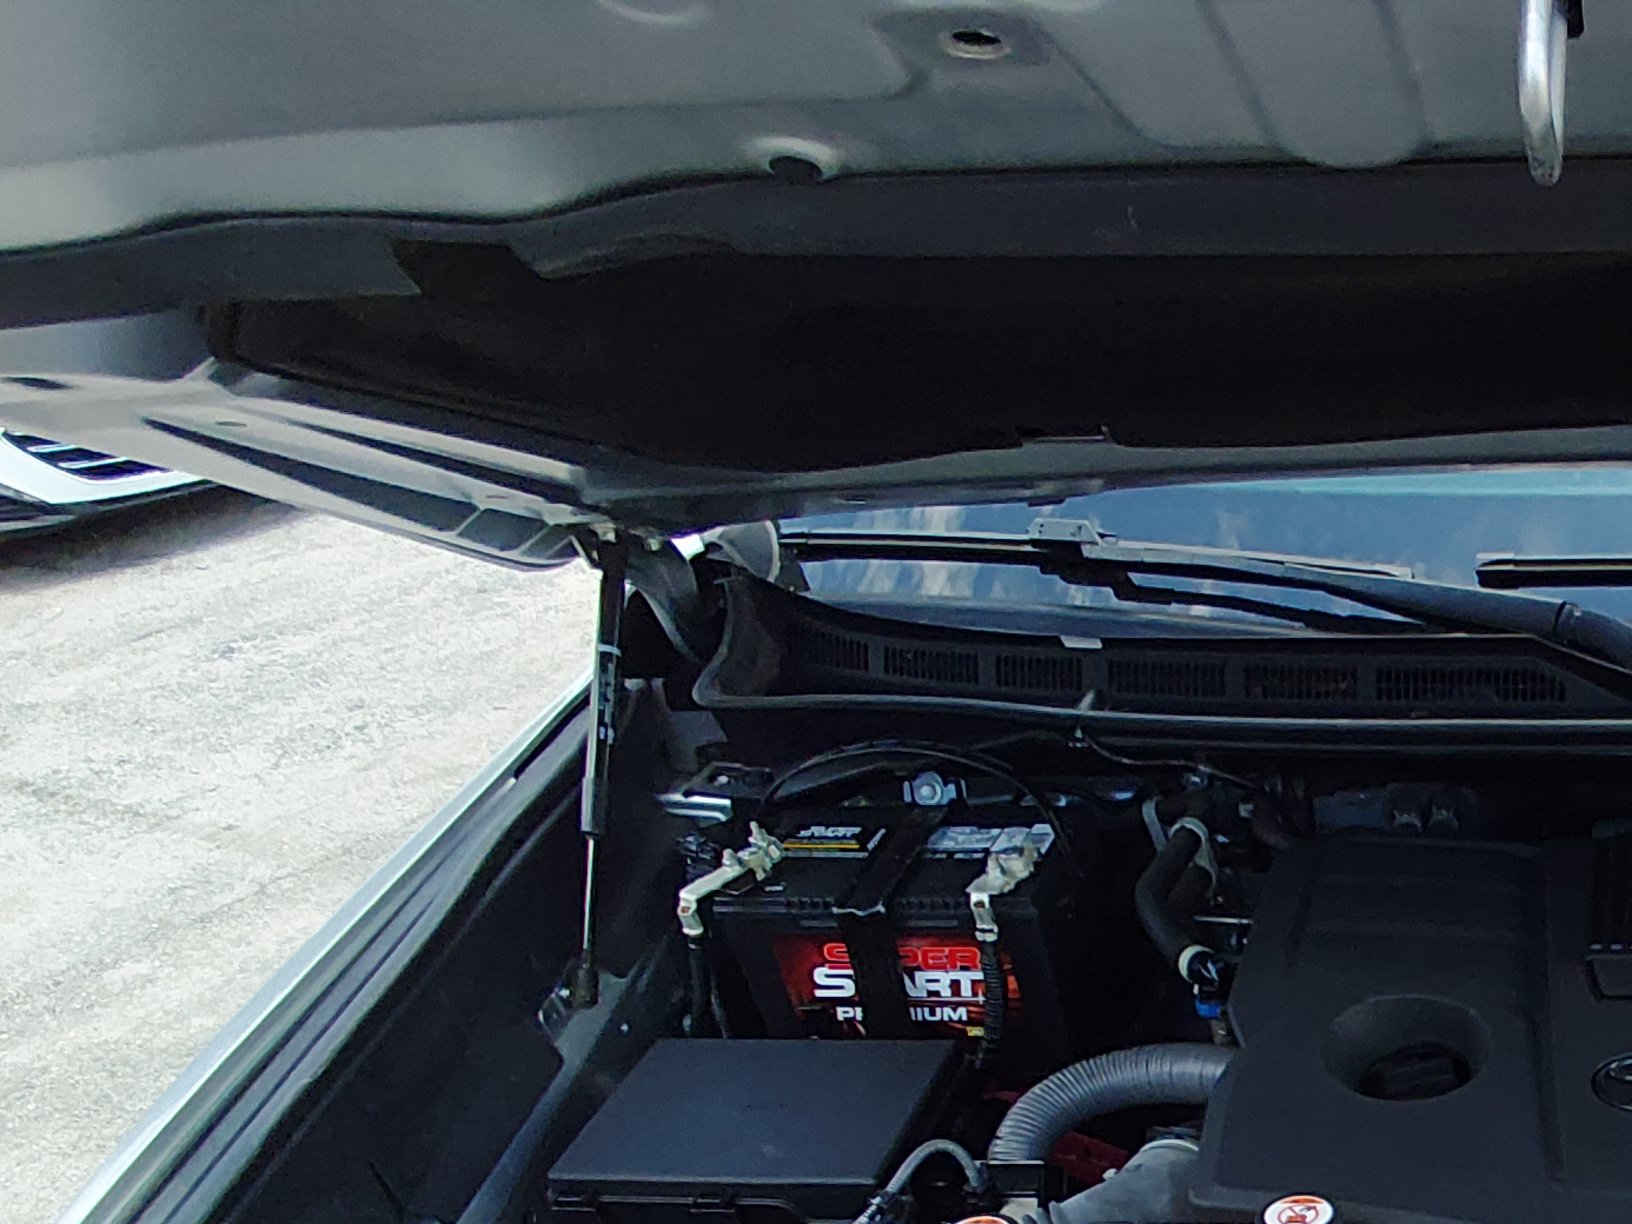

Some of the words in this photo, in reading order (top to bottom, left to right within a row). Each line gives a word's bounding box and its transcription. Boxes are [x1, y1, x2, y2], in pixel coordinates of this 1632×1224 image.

[823, 943, 981, 970] SPER
[813, 966, 985, 998] SRT
[835, 1006, 967, 1021] PIUM
